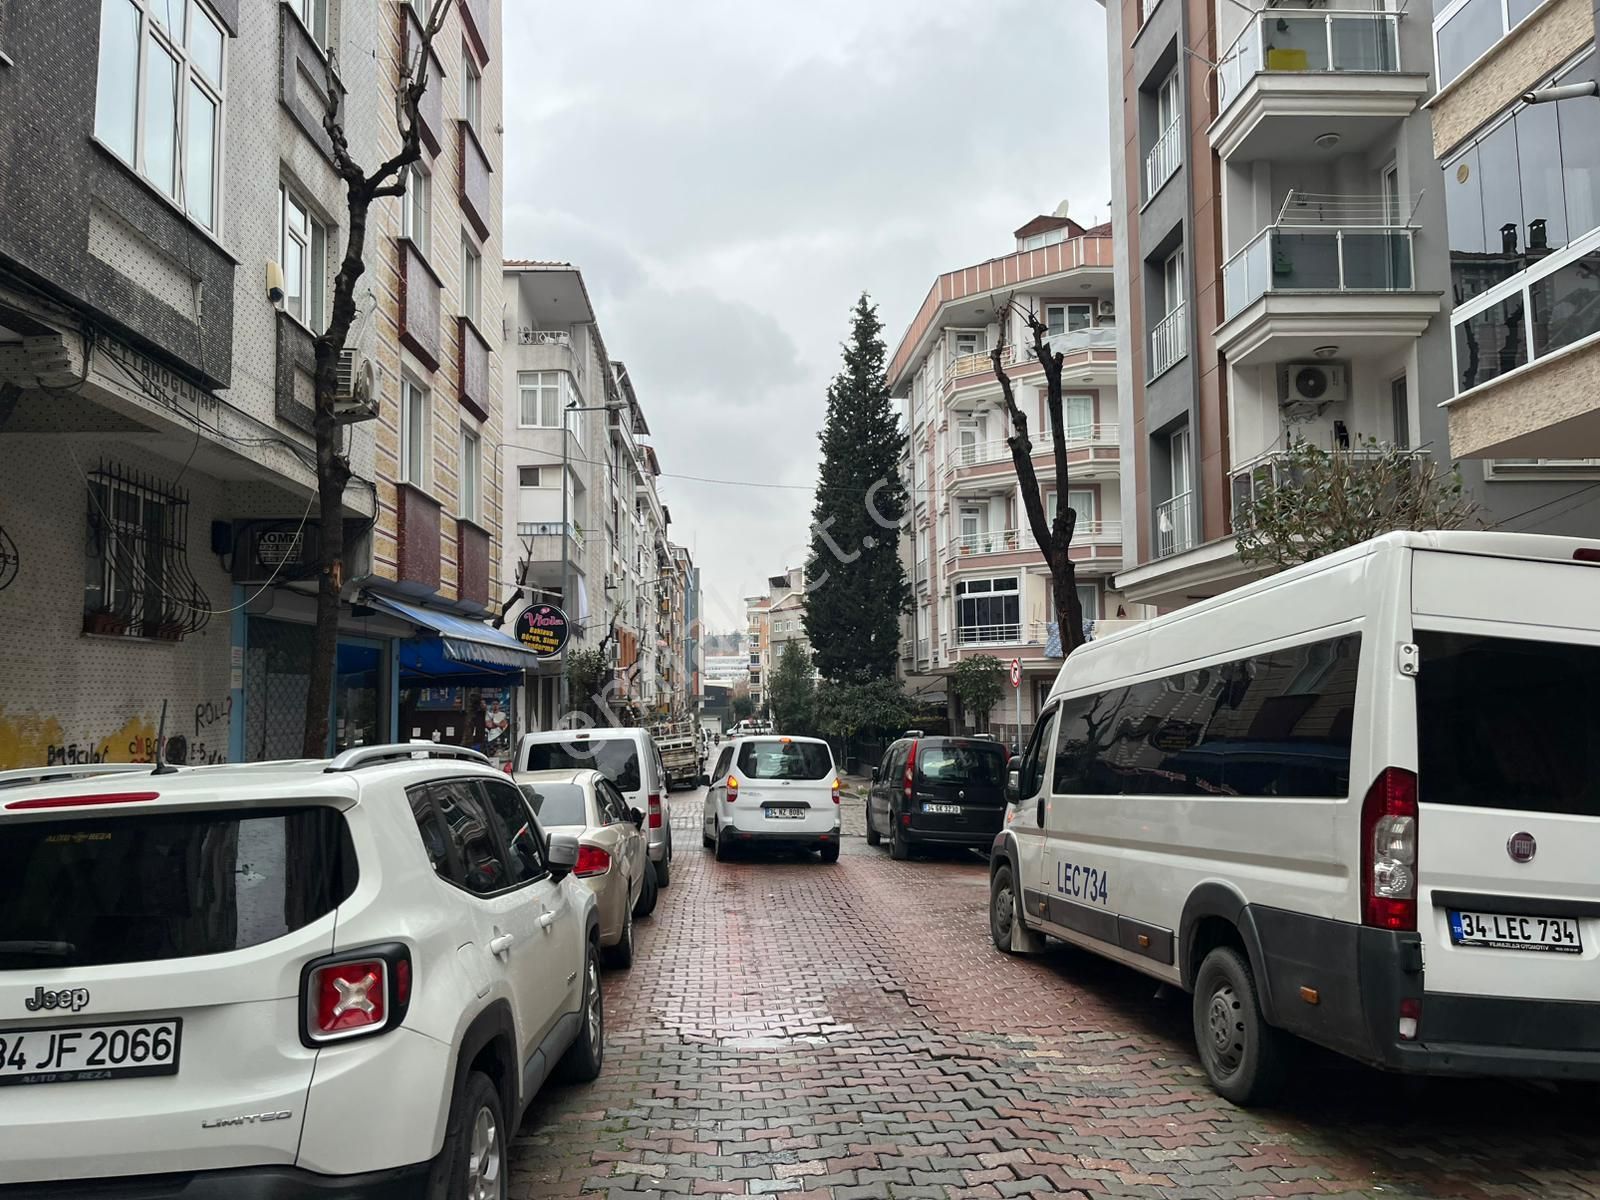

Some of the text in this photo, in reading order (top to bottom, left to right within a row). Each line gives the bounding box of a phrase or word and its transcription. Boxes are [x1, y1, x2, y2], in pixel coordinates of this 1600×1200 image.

[523, 612, 564, 627] Viola
[1463, 914, 1574, 944] 34 LEC 734
[25, 987, 89, 1012] Jeep
[36, 1032, 82, 1069] JF
[86, 1026, 172, 1065] 2066
[201, 1109, 292, 1128] LIMITED
